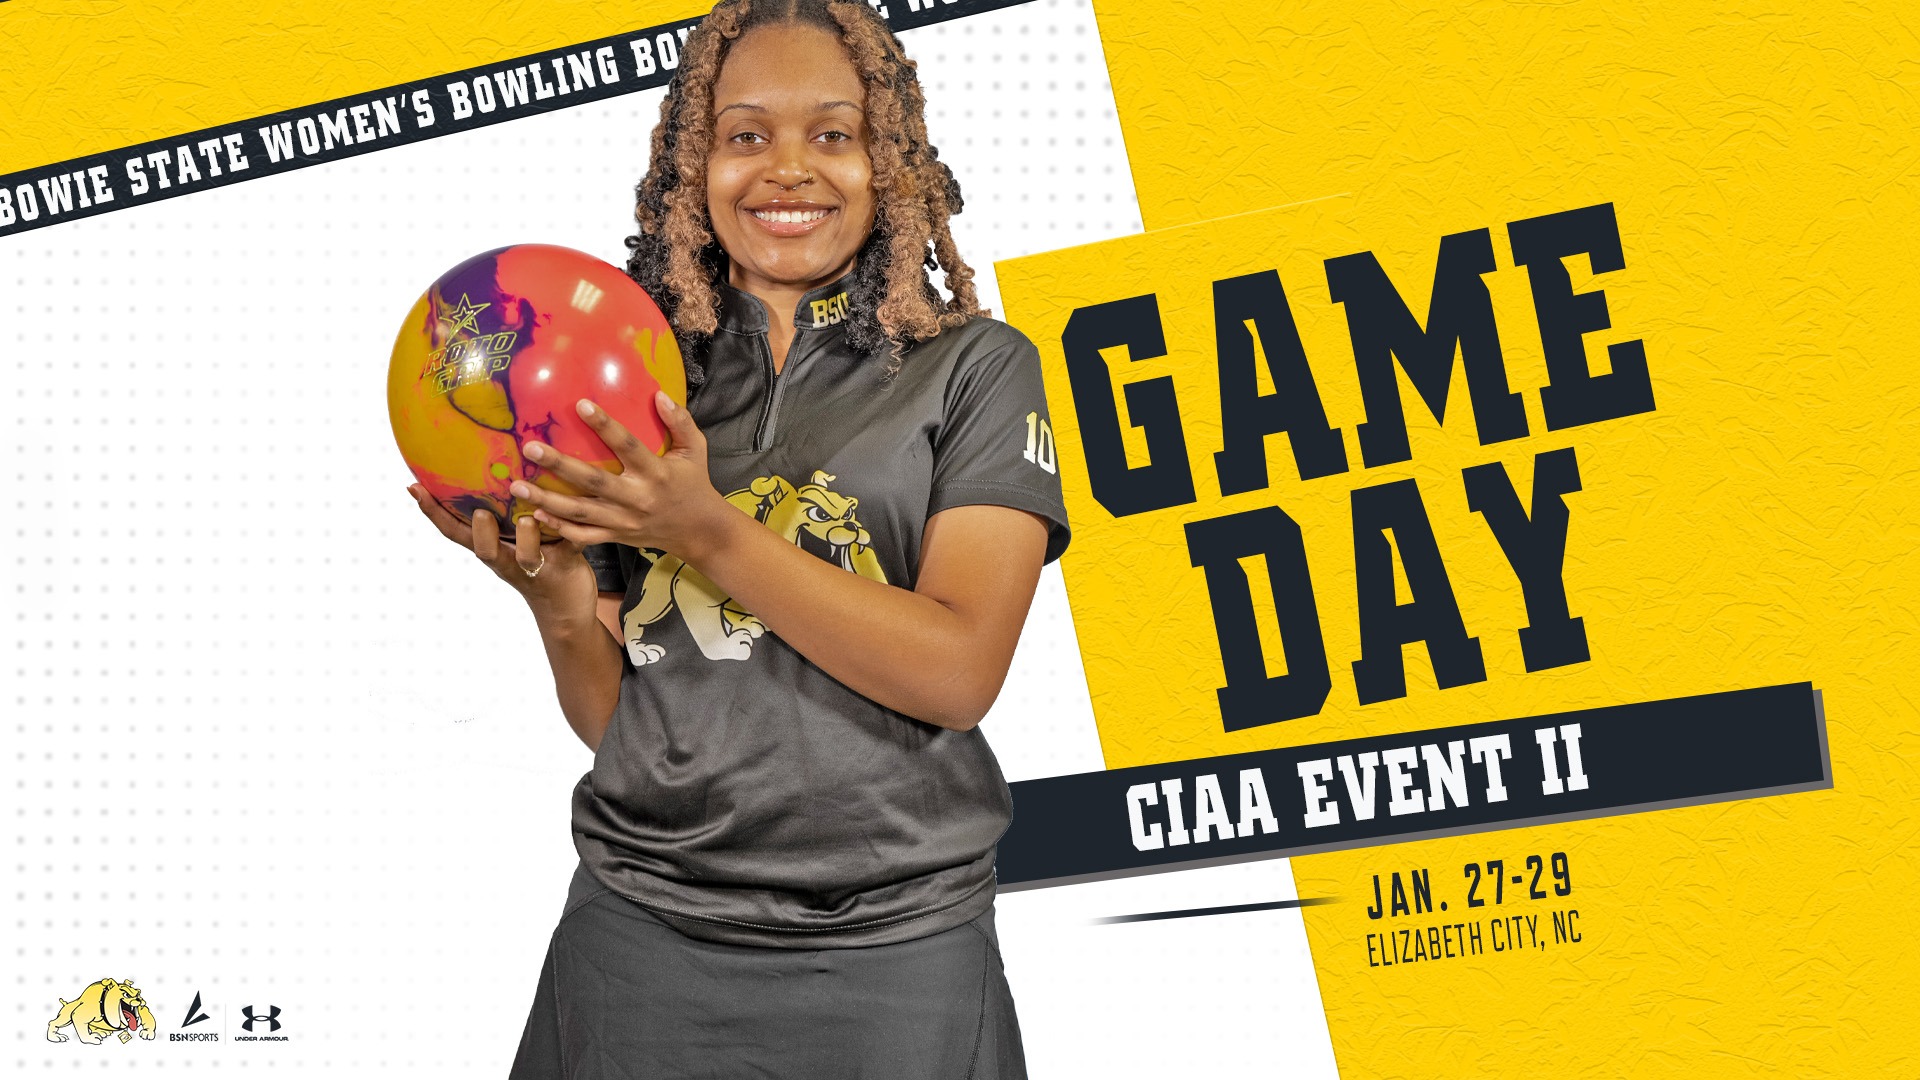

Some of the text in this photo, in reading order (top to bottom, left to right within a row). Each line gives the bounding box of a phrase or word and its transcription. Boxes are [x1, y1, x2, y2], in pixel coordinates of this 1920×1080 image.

[810, 292, 849, 328] BSU
[423, 331, 518, 378] ROTO
[430, 354, 512, 398] GRIP
[1023, 411, 1057, 475] 10
